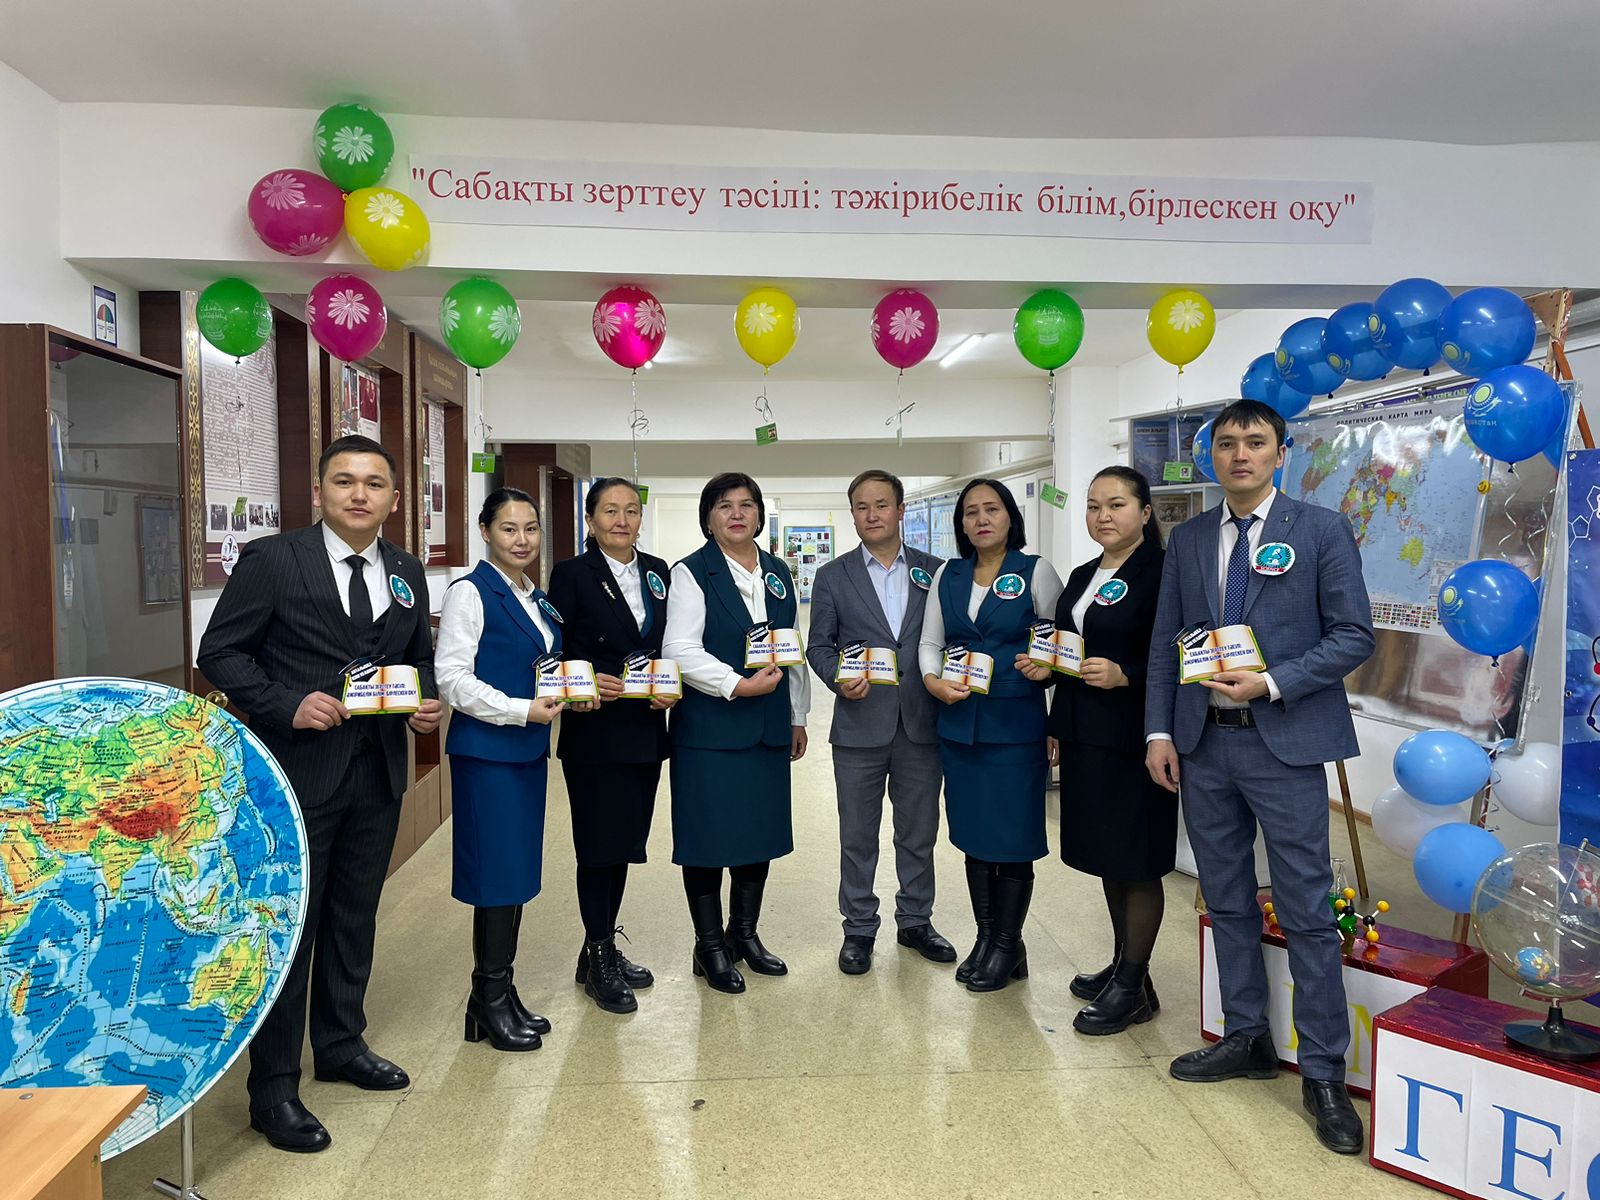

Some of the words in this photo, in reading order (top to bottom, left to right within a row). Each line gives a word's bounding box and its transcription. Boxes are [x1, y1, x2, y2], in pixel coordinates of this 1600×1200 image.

[411, 167, 573, 204] "Сабақты
[583, 182, 704, 216] зерттеу
[720, 180, 820, 210] тәсілі:
[833, 181, 1023, 217] тәжірибелік
[1037, 186, 1277, 225] білім,бірлескен
[1289, 194, 1356, 228] оқу"
[1388, 412, 1408, 420] КАРТА
[1395, 1074, 1600, 1200] ГЕ
